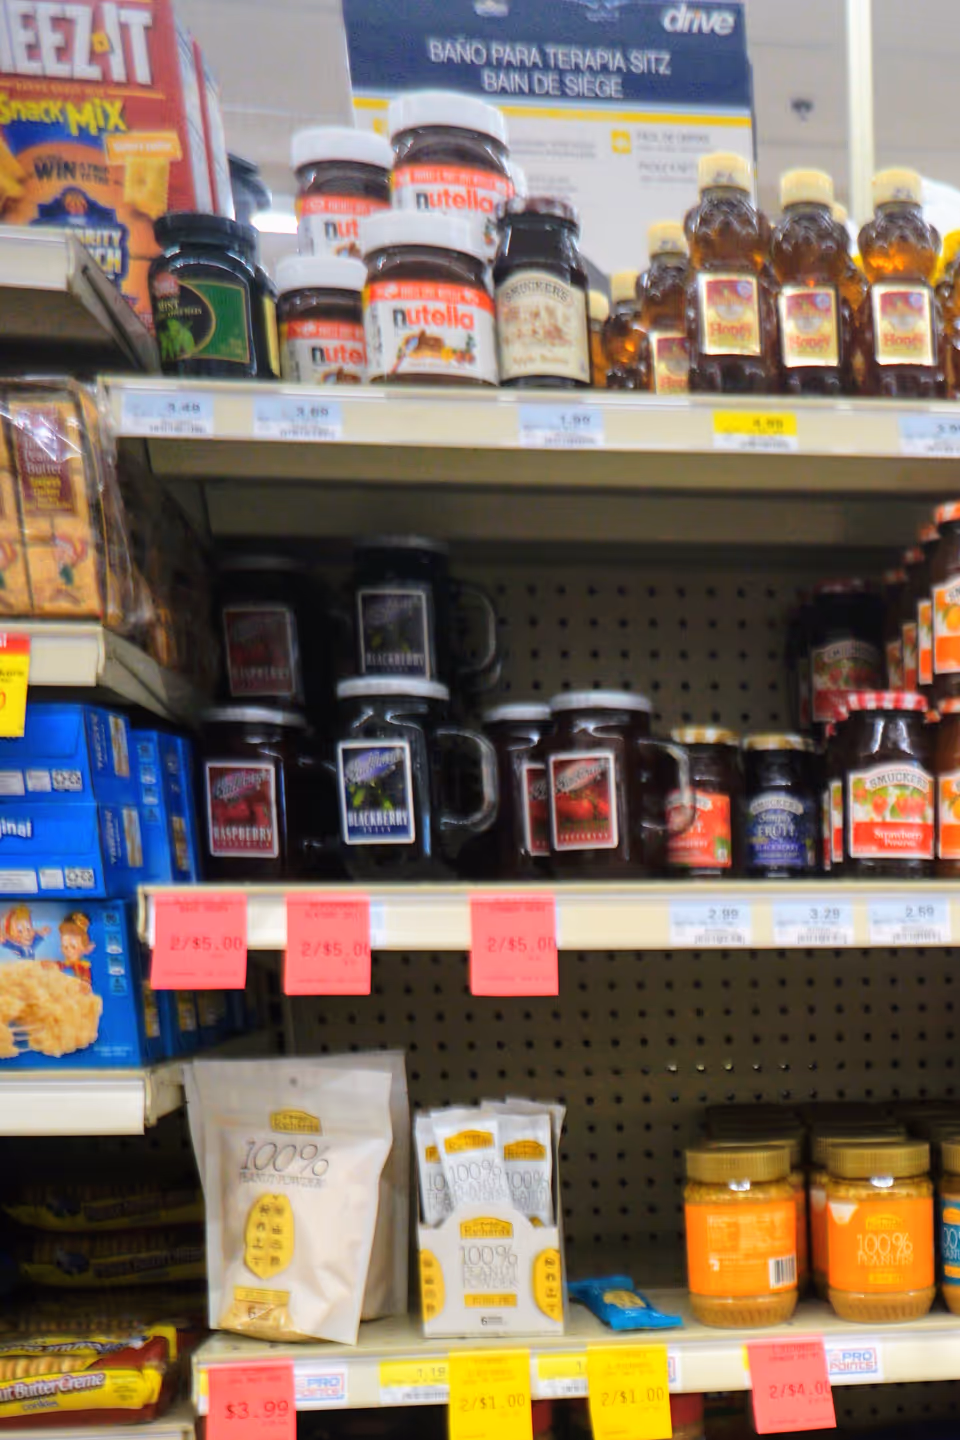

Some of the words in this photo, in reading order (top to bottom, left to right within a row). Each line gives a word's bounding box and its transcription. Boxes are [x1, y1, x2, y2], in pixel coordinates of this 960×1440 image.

[662, 5, 735, 36] drive
[428, 38, 487, 66] BAÑO
[491, 46, 542, 69] PARA
[546, 48, 627, 73] TERAPIA
[629, 53, 672, 75] SITZ
[482, 70, 530, 94] BAIN
[534, 72, 561, 96] DE
[564, 71, 624, 98] SIÈGE
[34, 159, 77, 182] WIN
[415, 189, 494, 213] nutella
[392, 305, 474, 331] nutella
[709, 322, 755, 338] Honey
[788, 335, 832, 352] Honey
[347, 810, 408, 828] BLACKBERRY
[213, 826, 273, 842] RASPBERRY
[874, 828, 925, 842] Strawberry
[170, 936, 243, 952] 2/$5.00
[240, 1140, 331, 1178] 100%
[451, 1160, 501, 1182] 100%
[506, 1170, 549, 1189] 100%
[855, 1233, 914, 1255] 100%
[461, 1245, 518, 1266] 100%
[842, 1350, 873, 1364] PRO
[460, 1394, 526, 1411] 2/$1.00
[602, 1388, 665, 1405] 2/$1.00
[224, 1400, 290, 1421] $3.99
